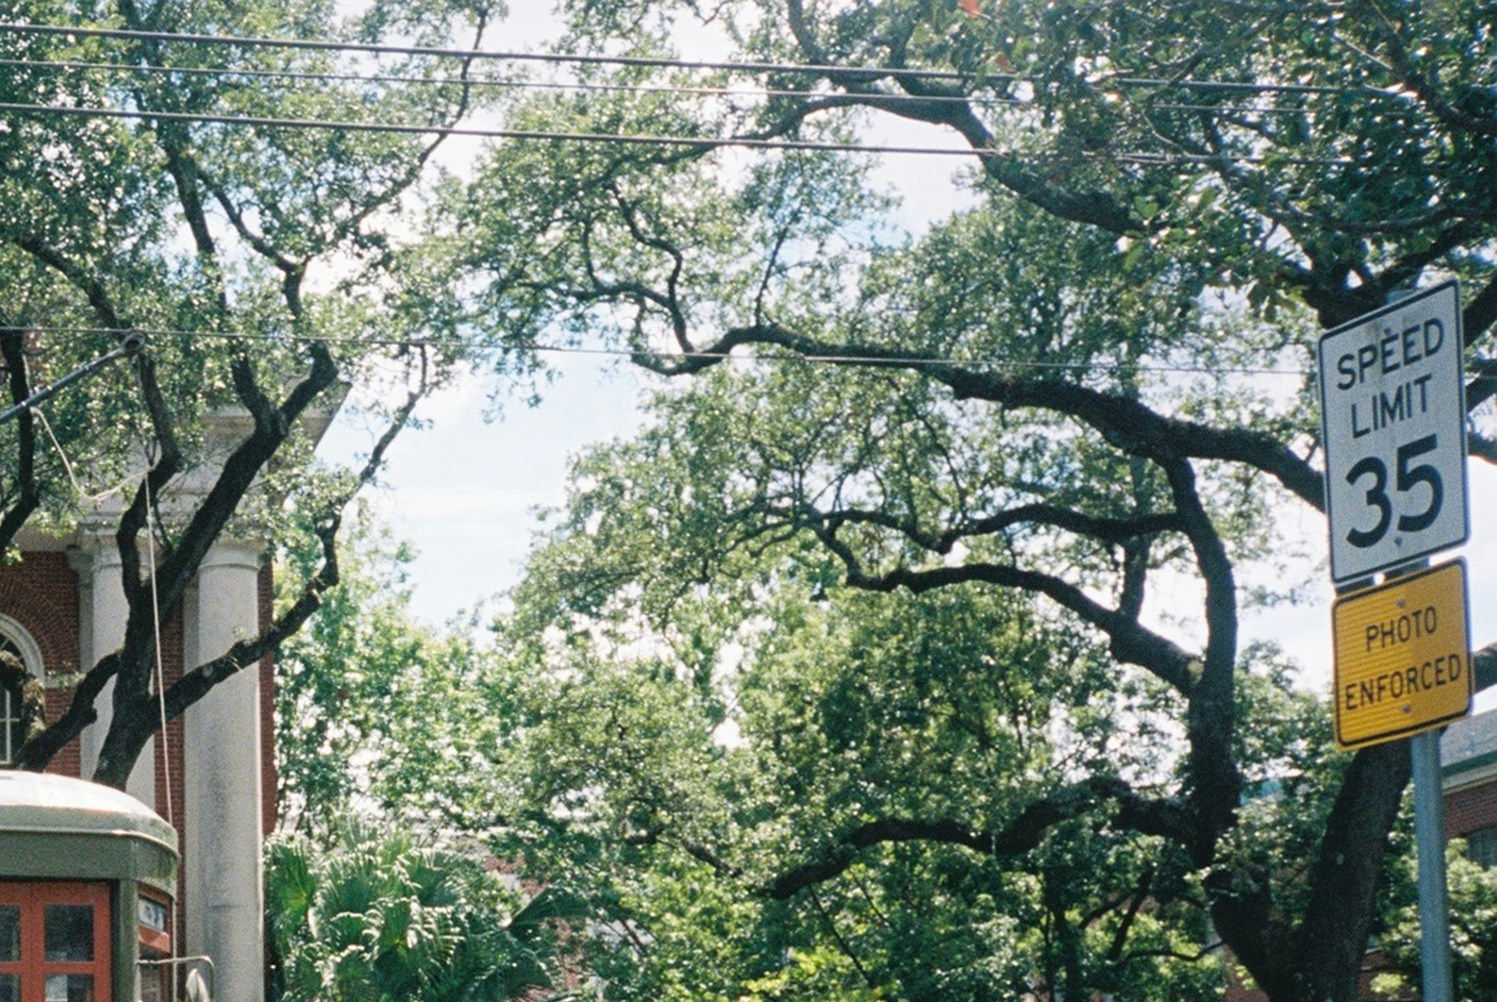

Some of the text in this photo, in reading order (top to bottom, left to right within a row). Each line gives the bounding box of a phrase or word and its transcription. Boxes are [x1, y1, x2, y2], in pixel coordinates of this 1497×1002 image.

[1336, 318, 1445, 392] SPEED
[1351, 372, 1433, 440] LIMIT
[1344, 433, 1445, 550] 35
[1365, 605, 1439, 655] PHOTO
[1344, 654, 1463, 713] ENFORCED
